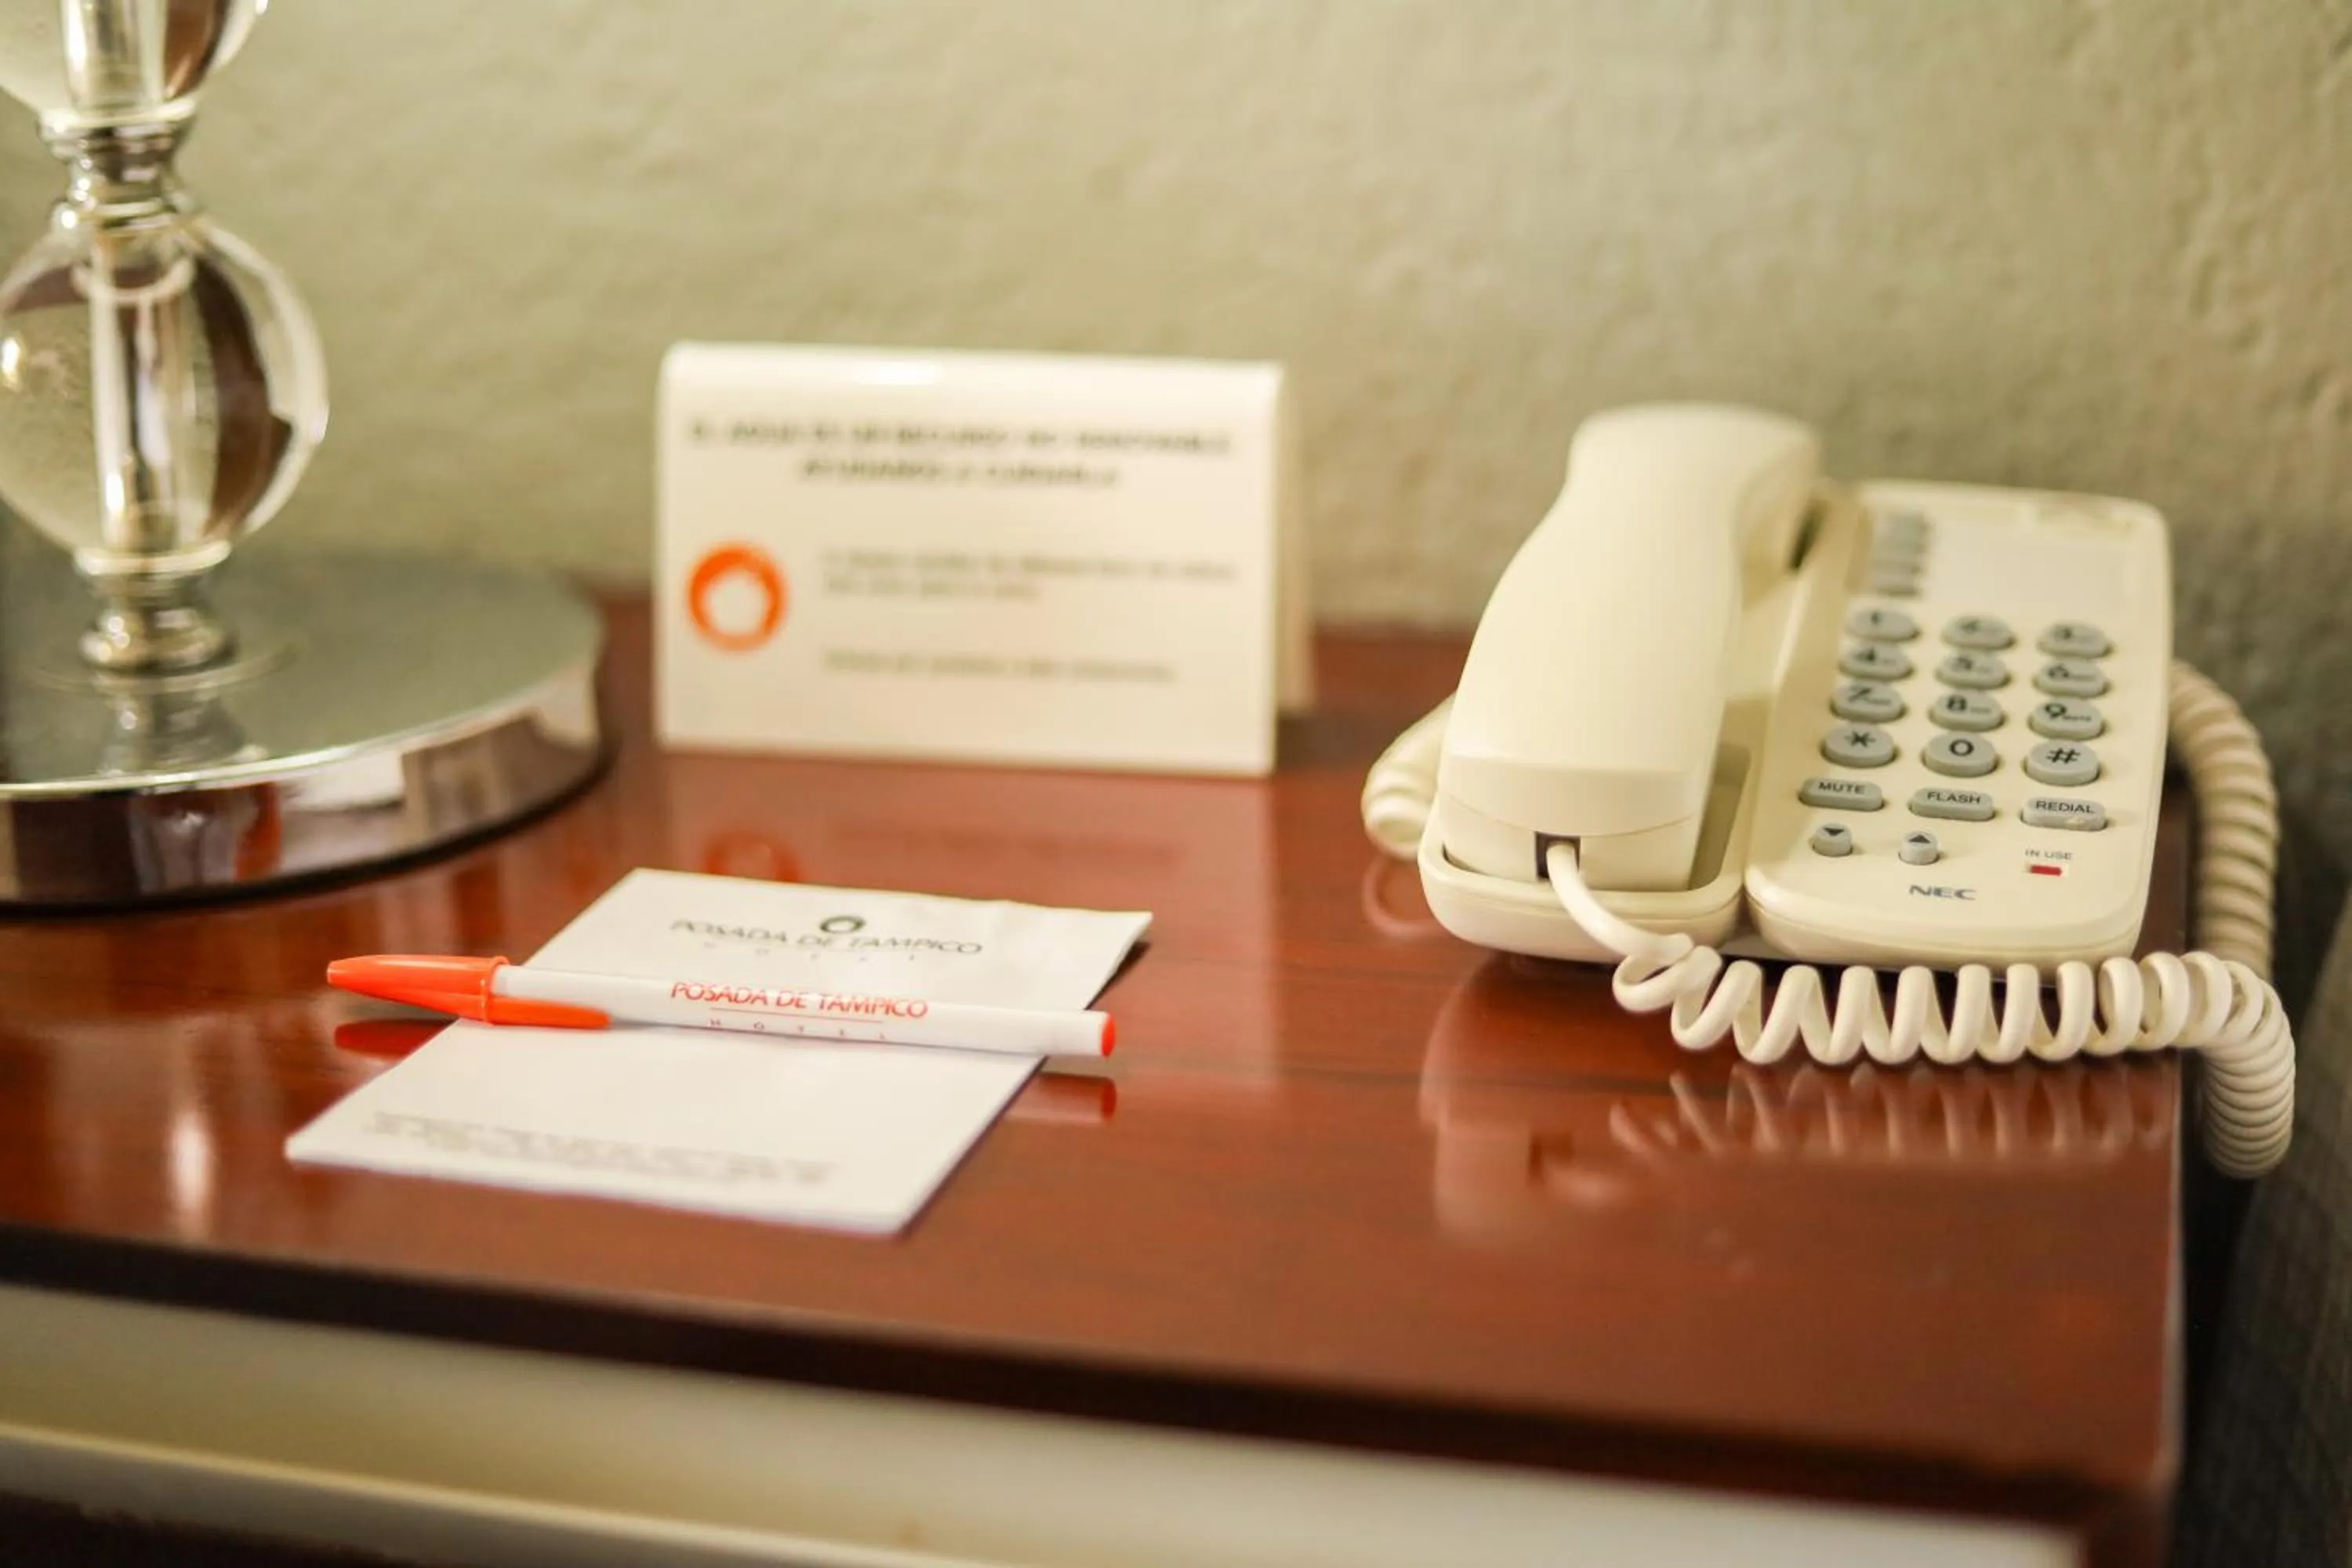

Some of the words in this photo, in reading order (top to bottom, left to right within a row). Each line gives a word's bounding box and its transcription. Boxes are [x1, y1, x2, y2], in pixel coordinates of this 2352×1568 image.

[1948, 738, 1975, 757] 0
[1817, 780, 1866, 795] MUTE
[1926, 790, 1982, 805] FLASH
[2034, 800, 2096, 815] REDIAL
[2024, 848, 2041, 859] IN
[2044, 850, 2074, 861] USE
[1908, 884, 1977, 902] NEC
[670, 982, 768, 1007] POSADA
[775, 989, 808, 1010] DE
[818, 992, 929, 1018] TAMPICO
